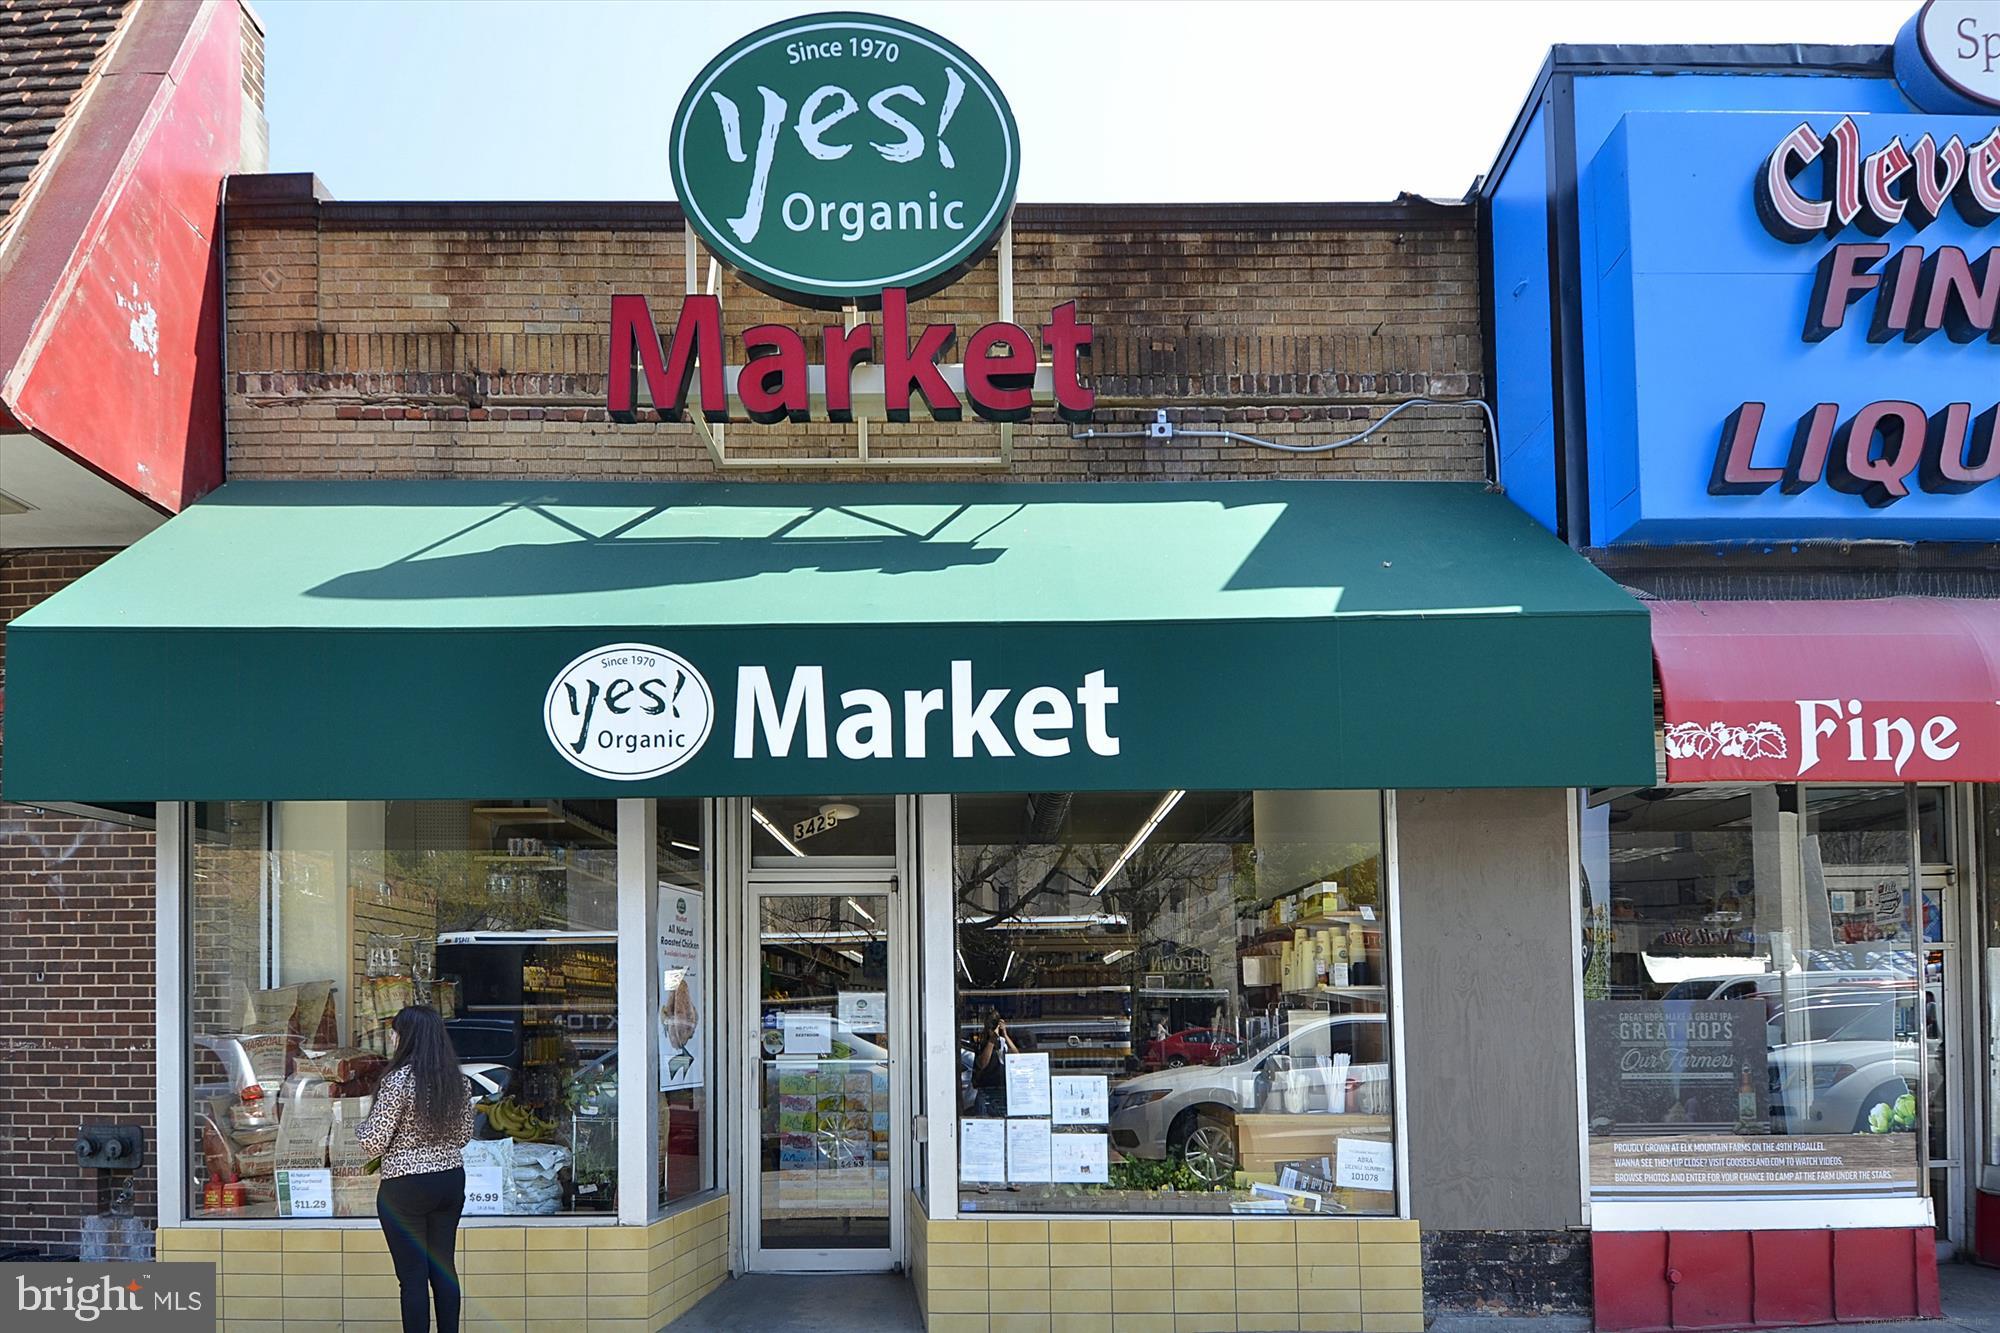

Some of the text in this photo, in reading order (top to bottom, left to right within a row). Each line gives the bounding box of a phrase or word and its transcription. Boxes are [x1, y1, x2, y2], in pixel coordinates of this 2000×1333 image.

[786, 37, 899, 64] Since 1970
[711, 67, 966, 244] yes!
[782, 190, 965, 242] Organic
[607, 287, 1096, 422] Market
[601, 655, 656, 669] Since 1970
[564, 669, 686, 755] yes!
[733, 660, 1121, 760] Market
[597, 729, 686, 753] Organic
[1795, 698, 1960, 777] Fine
[795, 810, 836, 839] 3425
[1620, 1021, 1733, 1040] GREAT HOPS
[1620, 1047, 1734, 1071] Our Farmers
[1613, 1143, 1643, 1153] PROUDLY
[1644, 1143, 1670, 1153] GROWN
[1680, 1143, 1693, 1153] ELK
[1694, 1143, 1728, 1153] MOUNTAIN
[1729, 1142, 1751, 1152] FARMS
[1752, 1142, 1762, 1152] ON
[1763, 1142, 1775, 1152] THE
[1775, 1142, 1792, 1152] 49TH
[1614, 1159, 1640, 1168] WANNA
[1641, 1159, 1653, 1168] SEE
[1654, 1159, 1674, 1168] THEM
[1674, 1159, 1683, 1168] UP
[1708, 1158, 1725, 1167] VISIT
[1786, 1158, 1794, 1167] TO
[1795, 1157, 1818, 1166] WATCH
[1351, 1172, 1379, 1182] 101078
[1614, 1174, 1643, 1183] BROWSE
[1644, 1174, 1670, 1183] PHOTOS
[1671, 1174, 1685, 1183] AND
[1686, 1174, 1706, 1183] ENTER
[1707, 1174, 1720, 1183] FOR
[1721, 1173, 1738, 1182] YOUR
[1739, 1173, 1765, 1182] CHANCE
[1766, 1173, 1774, 1182] TO
[1775, 1172, 1795, 1181] CAMP
[1804, 1172, 1816, 1181] THE
[1817, 1172, 1836, 1181] FARM
[1837, 1171, 1857, 1180] UNDER
[1858, 1171, 1871, 1180] THE
[295, 1200, 327, 1209] $11.29
[469, 1192, 499, 1202] $6.99
